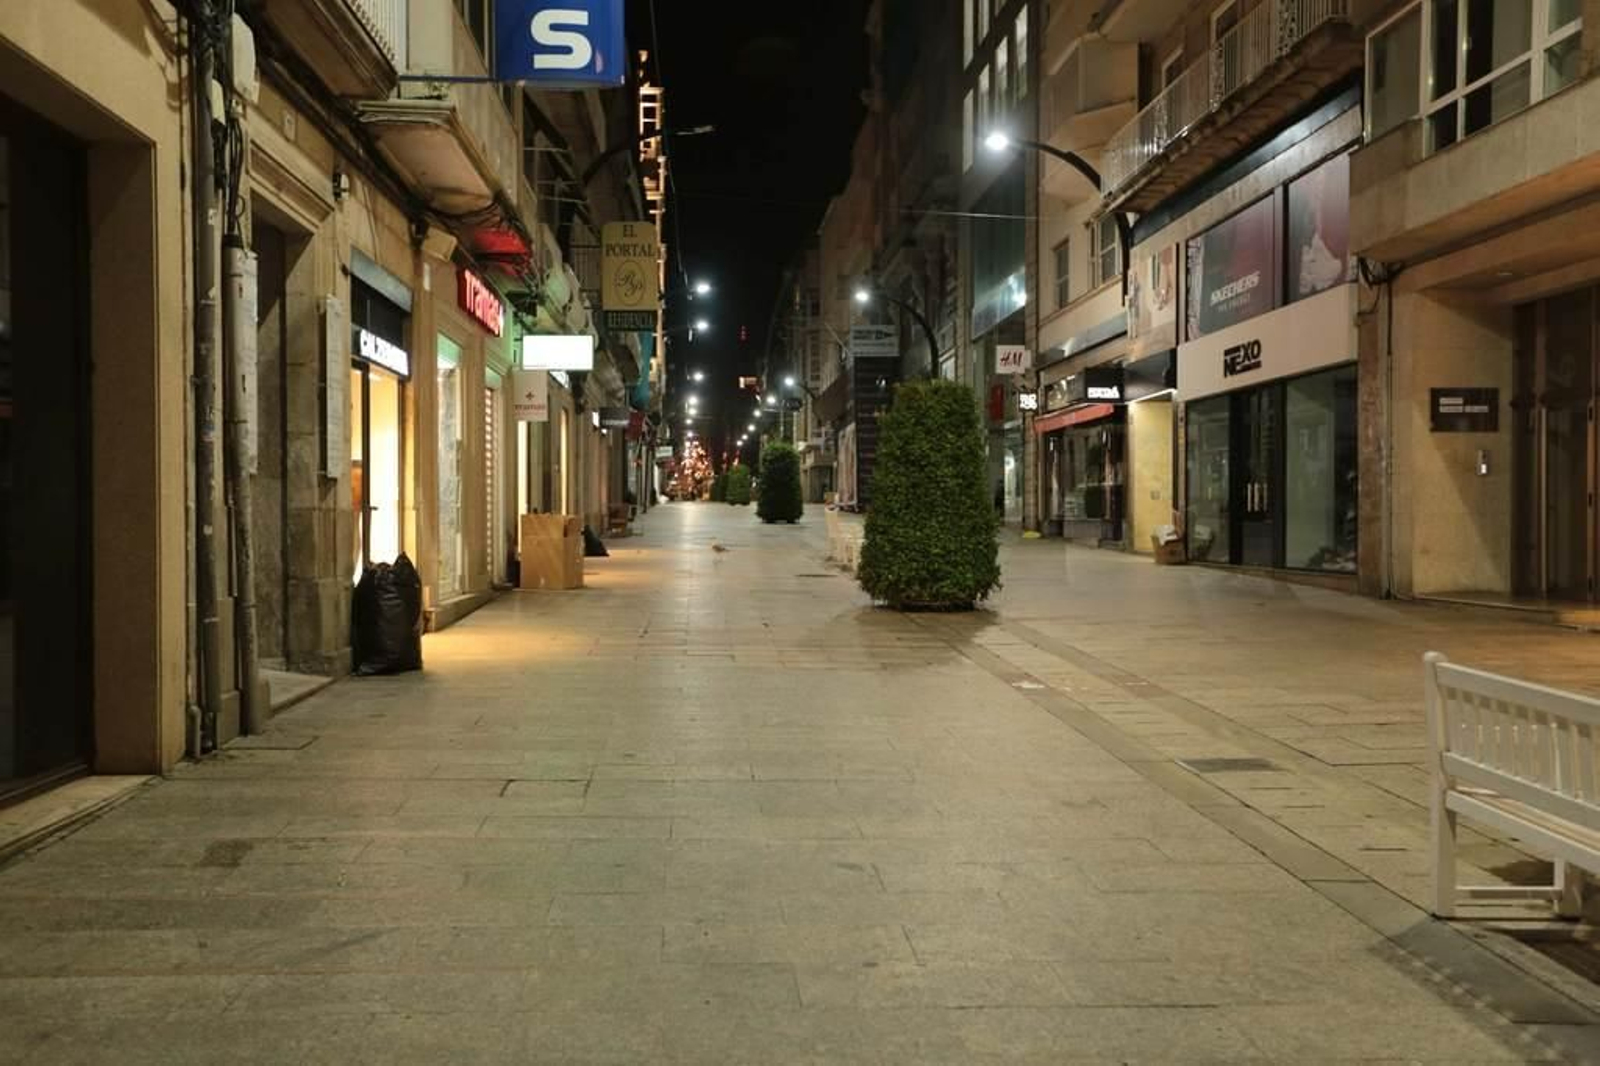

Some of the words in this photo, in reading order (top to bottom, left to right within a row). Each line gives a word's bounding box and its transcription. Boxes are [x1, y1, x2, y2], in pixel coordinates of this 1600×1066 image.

[530, 8, 593, 70] S
[623, 224, 638, 238] EL
[605, 243, 655, 257] PORTAL
[1209, 270, 1261, 307] SKECHERS
[1223, 338, 1262, 378] NEXO
